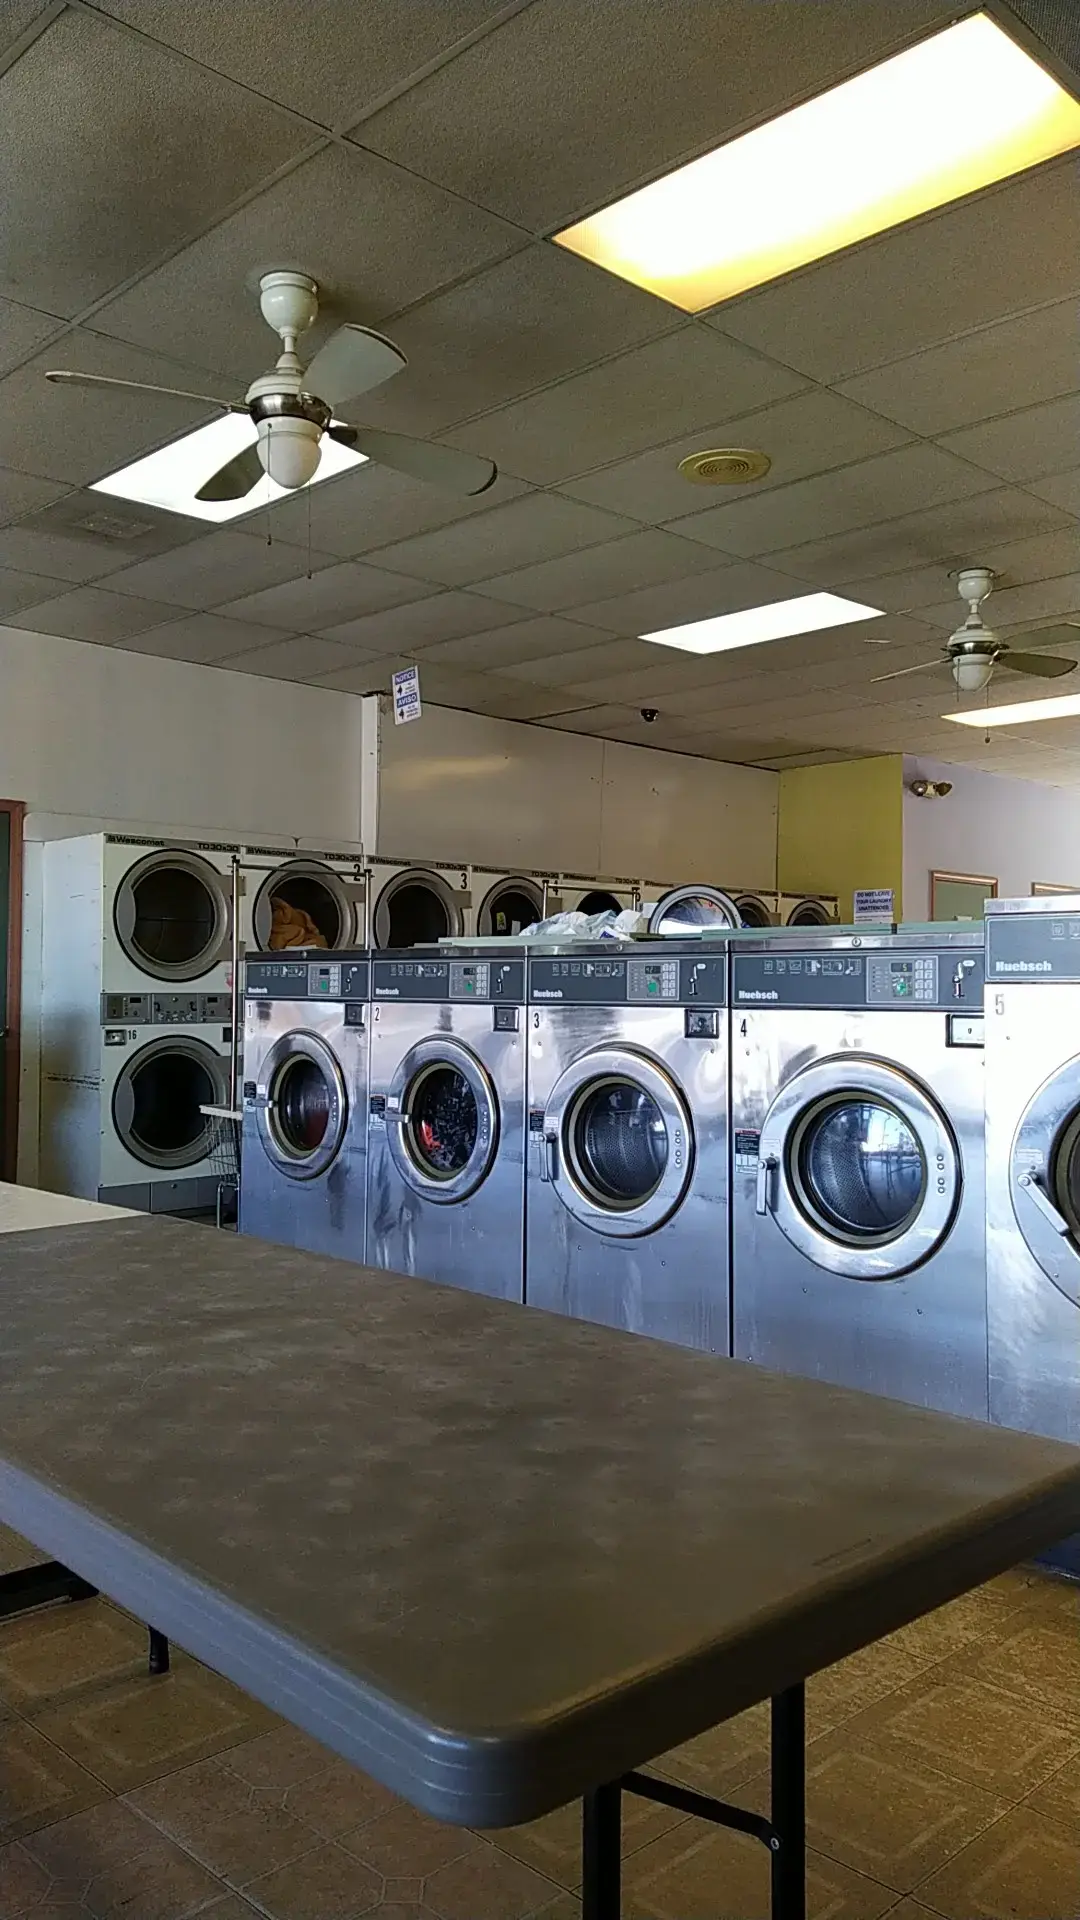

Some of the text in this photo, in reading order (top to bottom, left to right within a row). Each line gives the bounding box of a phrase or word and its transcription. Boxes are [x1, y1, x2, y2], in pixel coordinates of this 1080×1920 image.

[396, 670, 415, 684] NOTICE
[398, 693, 417, 706] AVISO
[353, 863, 361, 881] 2
[460, 872, 468, 889] 3
[995, 960, 1053, 972] Huebsch
[533, 989, 563, 998] Huebsch
[738, 989, 779, 1000] Huebsch
[995, 993, 1005, 1016] 5
[375, 1007, 380, 1021] 2
[533, 1012, 540, 1029] 3
[128, 1029, 137, 1040] 16
[740, 1018, 748, 1037] 4
